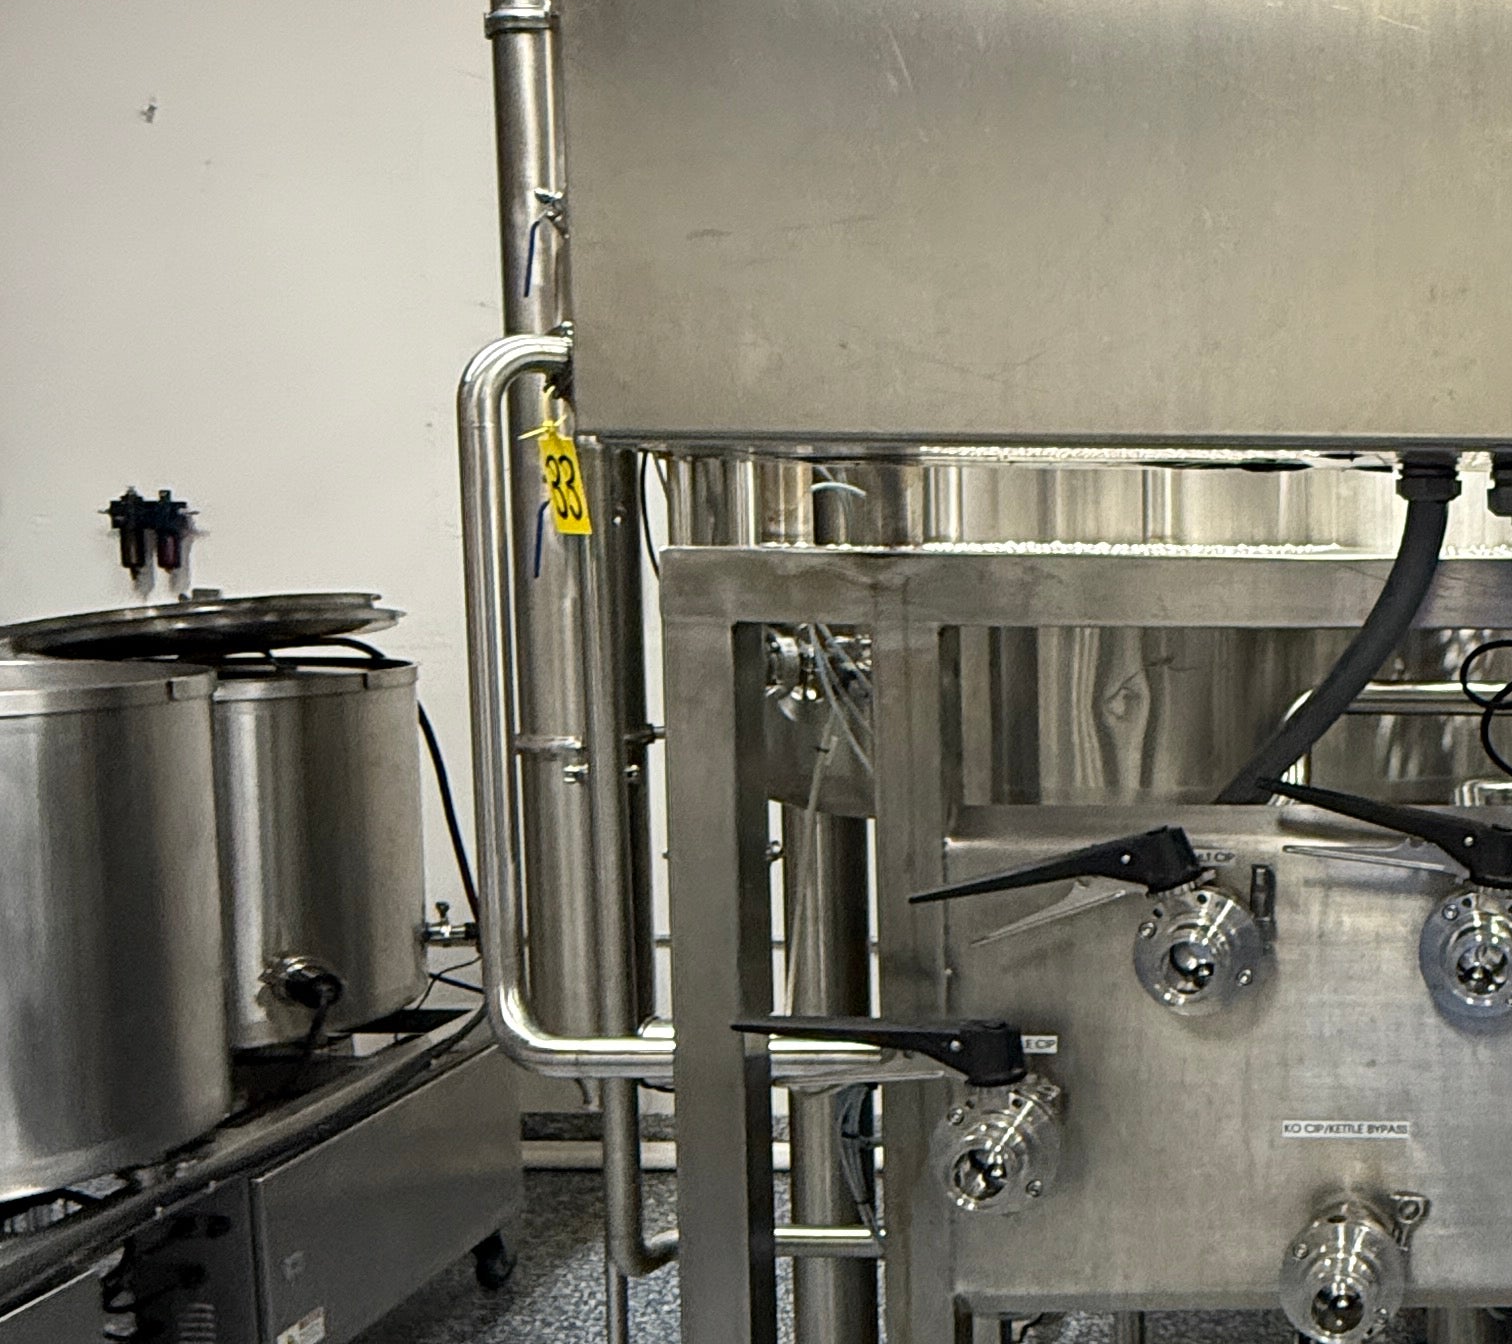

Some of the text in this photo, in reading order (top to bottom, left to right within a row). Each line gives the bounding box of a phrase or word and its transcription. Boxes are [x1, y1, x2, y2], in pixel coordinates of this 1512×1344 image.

[545, 454, 583, 521] 33
[1284, 1123, 1302, 1134] KO
[1366, 1124, 1408, 1135] BYPASS
